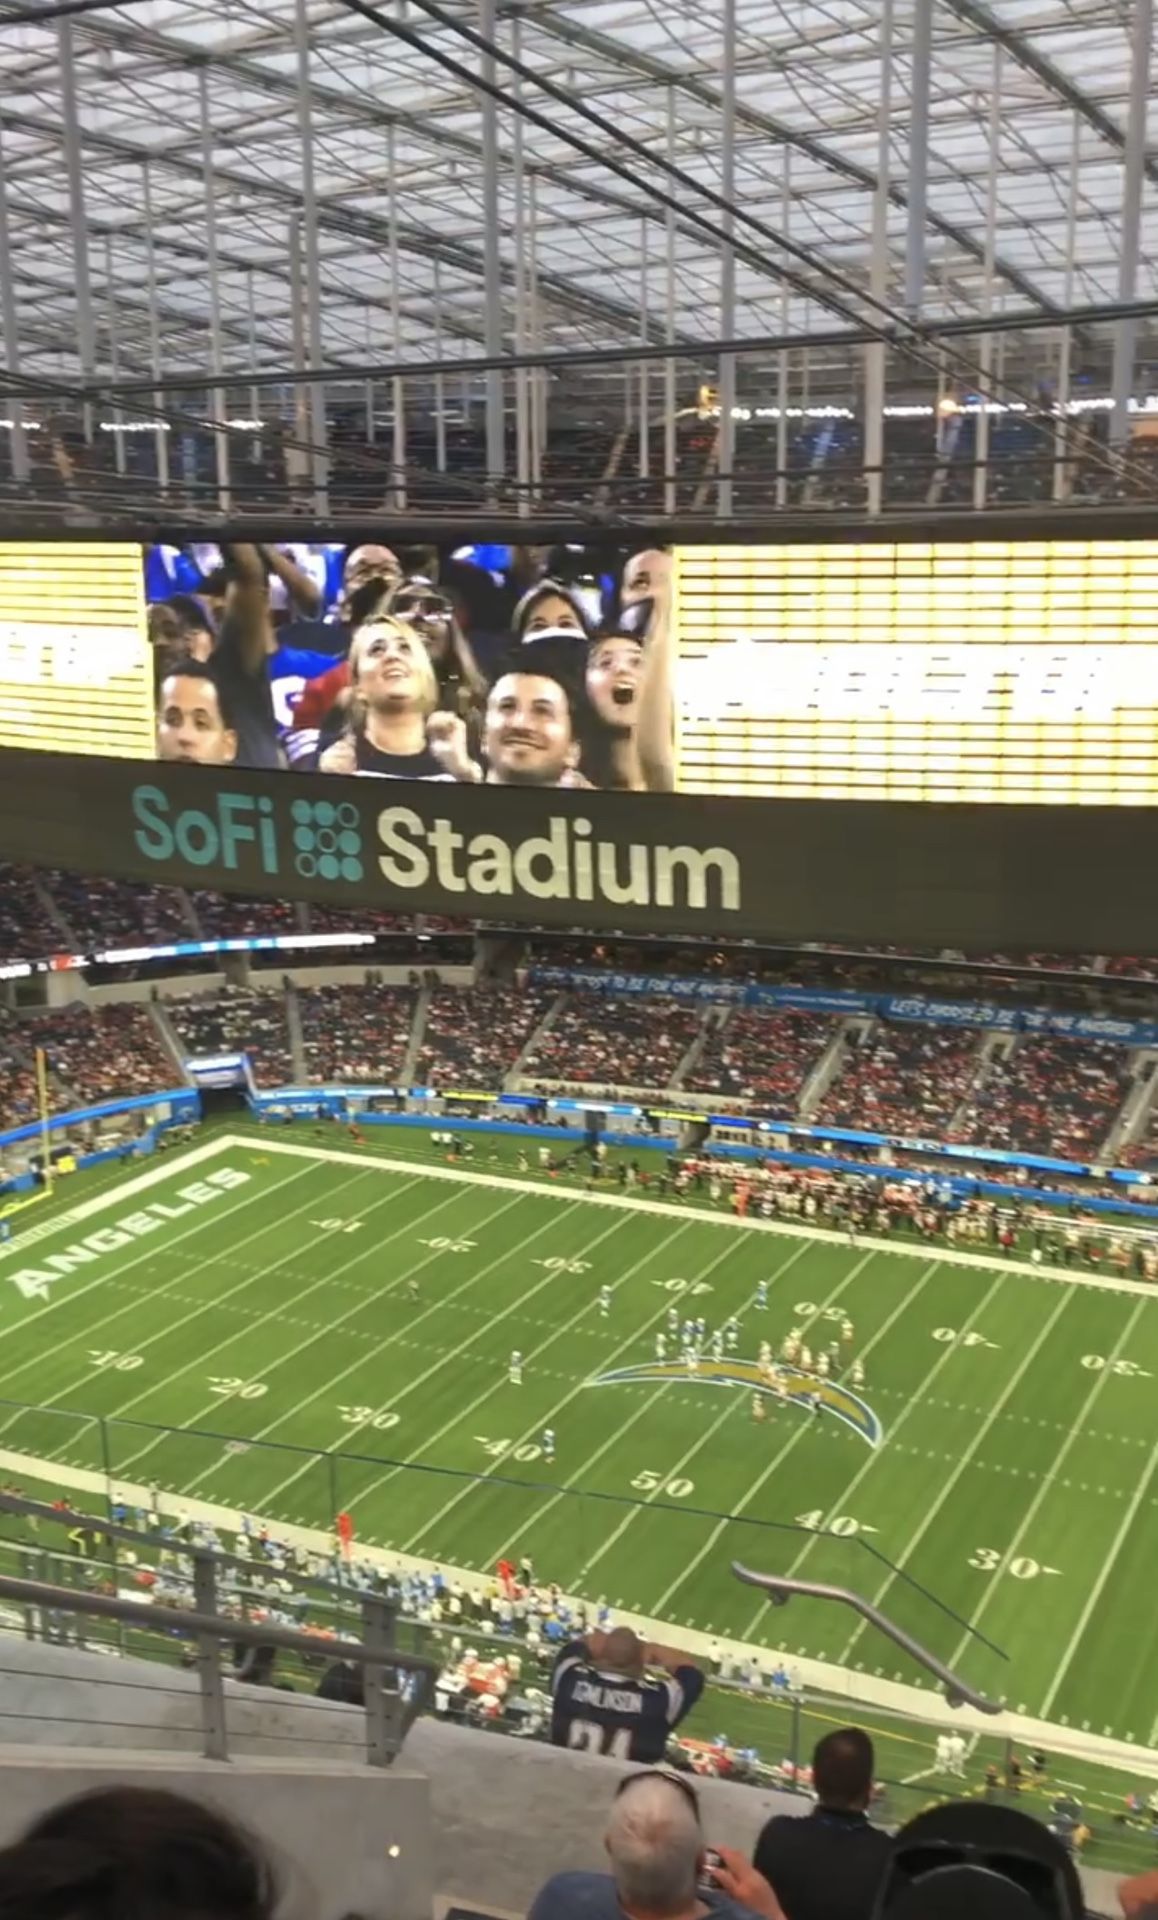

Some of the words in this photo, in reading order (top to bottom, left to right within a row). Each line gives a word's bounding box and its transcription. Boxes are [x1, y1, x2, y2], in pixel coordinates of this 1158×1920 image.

[132, 783, 279, 874] SoFi
[376, 805, 742, 912] Stadium
[5, 1167, 252, 1302] ANGELES
[92, 1351, 145, 1372] 10
[209, 1377, 269, 1400] 20
[341, 1406, 401, 1430] 30
[482, 1436, 543, 1463] 40
[630, 1469, 696, 1499] 50
[794, 1507, 860, 1538] 40
[968, 1547, 1041, 1580] 30
